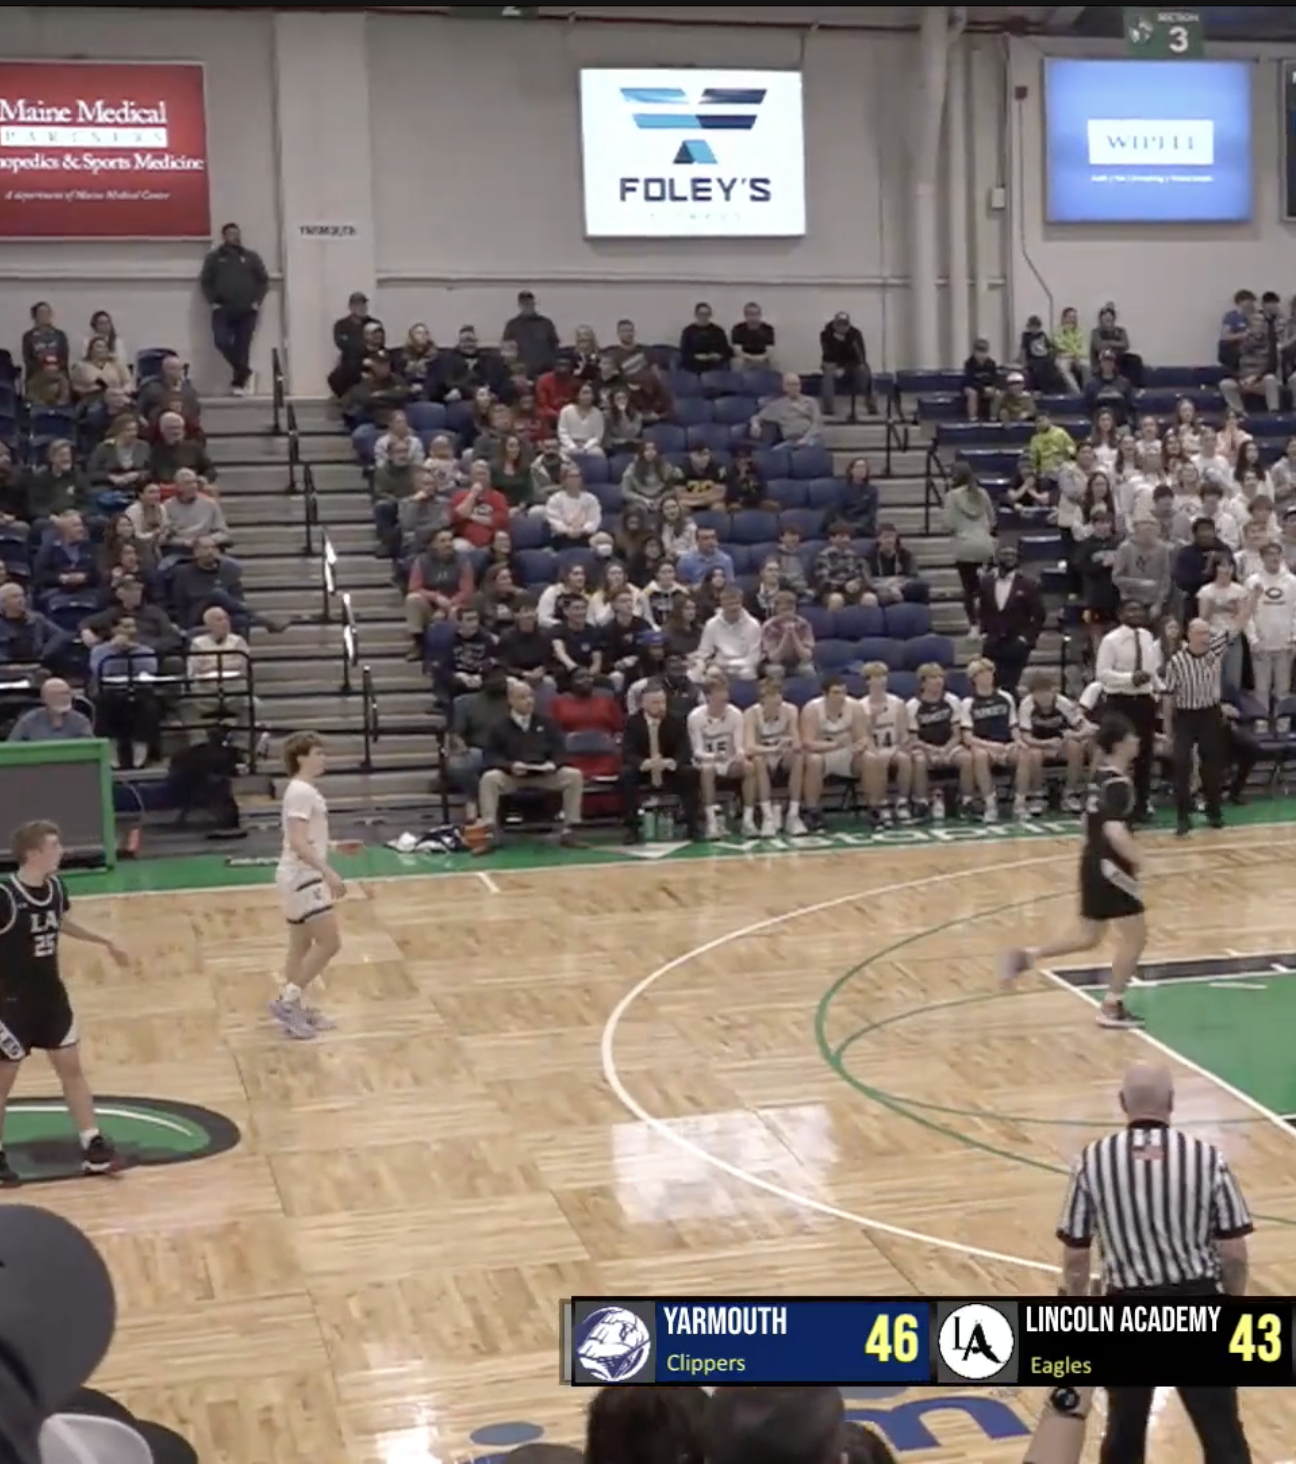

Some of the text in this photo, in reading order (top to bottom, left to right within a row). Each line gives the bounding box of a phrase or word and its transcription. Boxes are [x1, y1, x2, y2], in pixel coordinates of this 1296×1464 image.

[1169, 26, 1188, 53] 3
[0, 98, 167, 124] Maine Medical
[62, 154, 82, 170] &
[83, 153, 130, 175] Sports
[133, 153, 204, 171] Medicine
[620, 177, 771, 202] FOLEY'S
[30, 910, 59, 934] LA
[34, 933, 57, 958] 25
